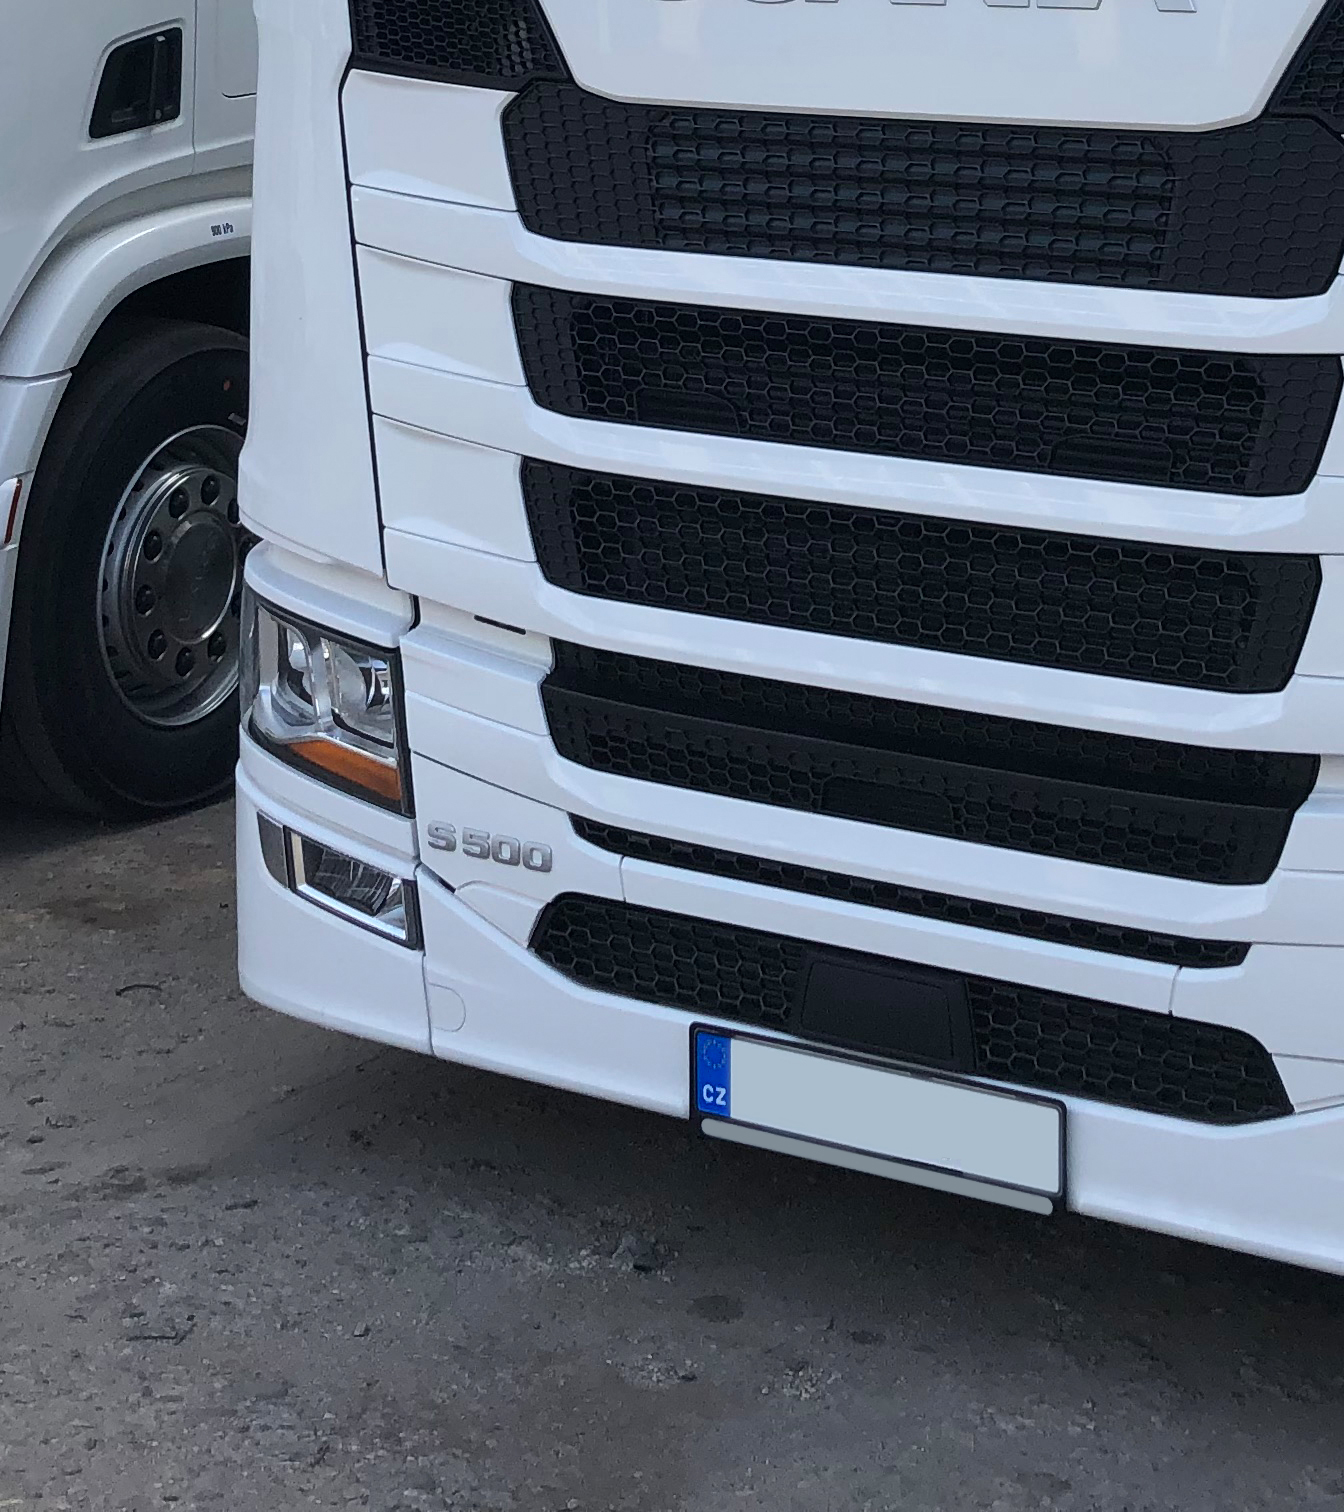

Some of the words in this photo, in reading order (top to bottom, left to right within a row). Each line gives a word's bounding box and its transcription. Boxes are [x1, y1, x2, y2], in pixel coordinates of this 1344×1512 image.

[427, 819, 457, 853] S
[462, 826, 554, 873] 500
[702, 1083, 727, 1106] CZ
